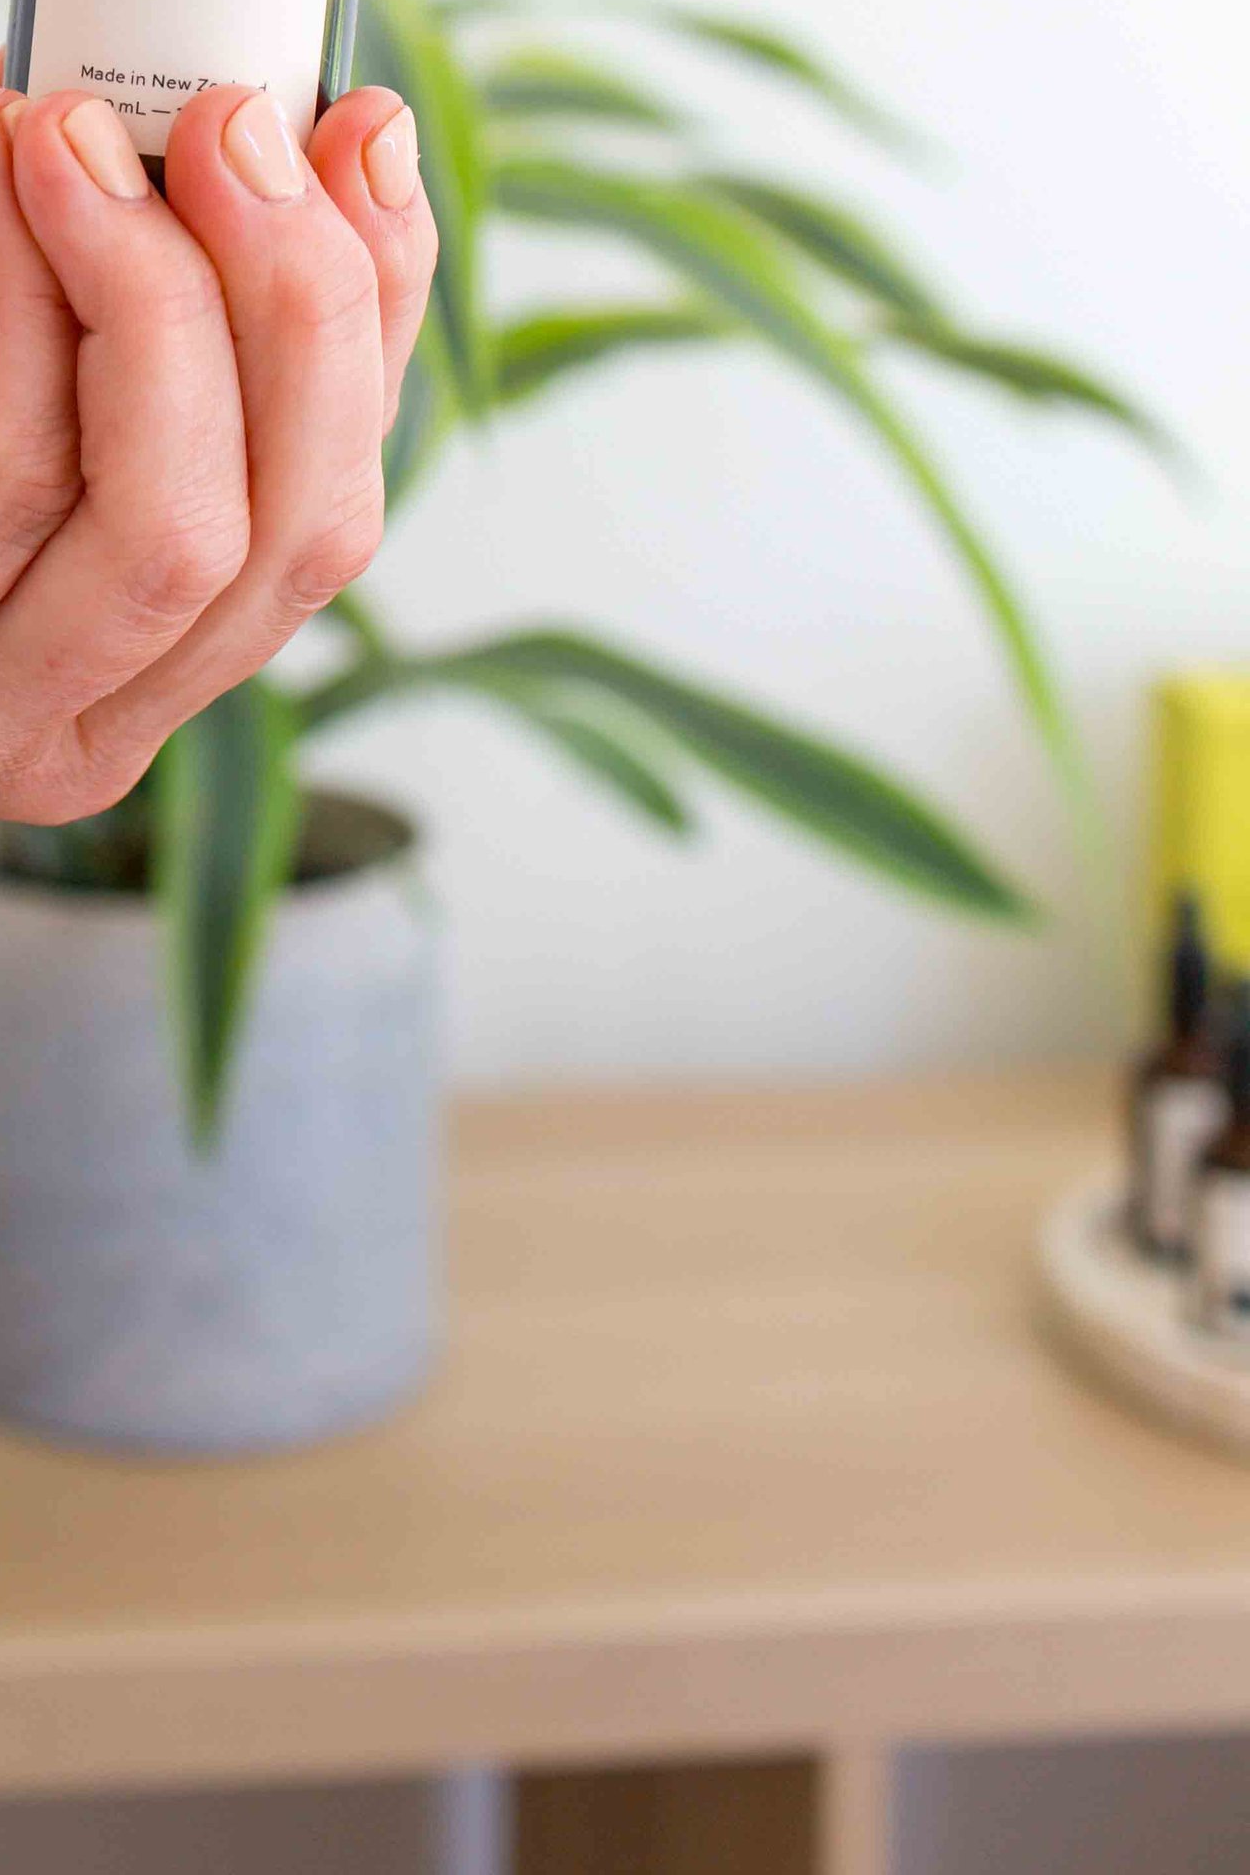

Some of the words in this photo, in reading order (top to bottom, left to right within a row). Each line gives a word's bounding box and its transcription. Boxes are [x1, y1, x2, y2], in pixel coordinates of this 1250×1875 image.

[80, 65, 126, 83] Made
[130, 70, 146, 86] in
[152, 74, 192, 91] New
[119, 100, 147, 116] mL
